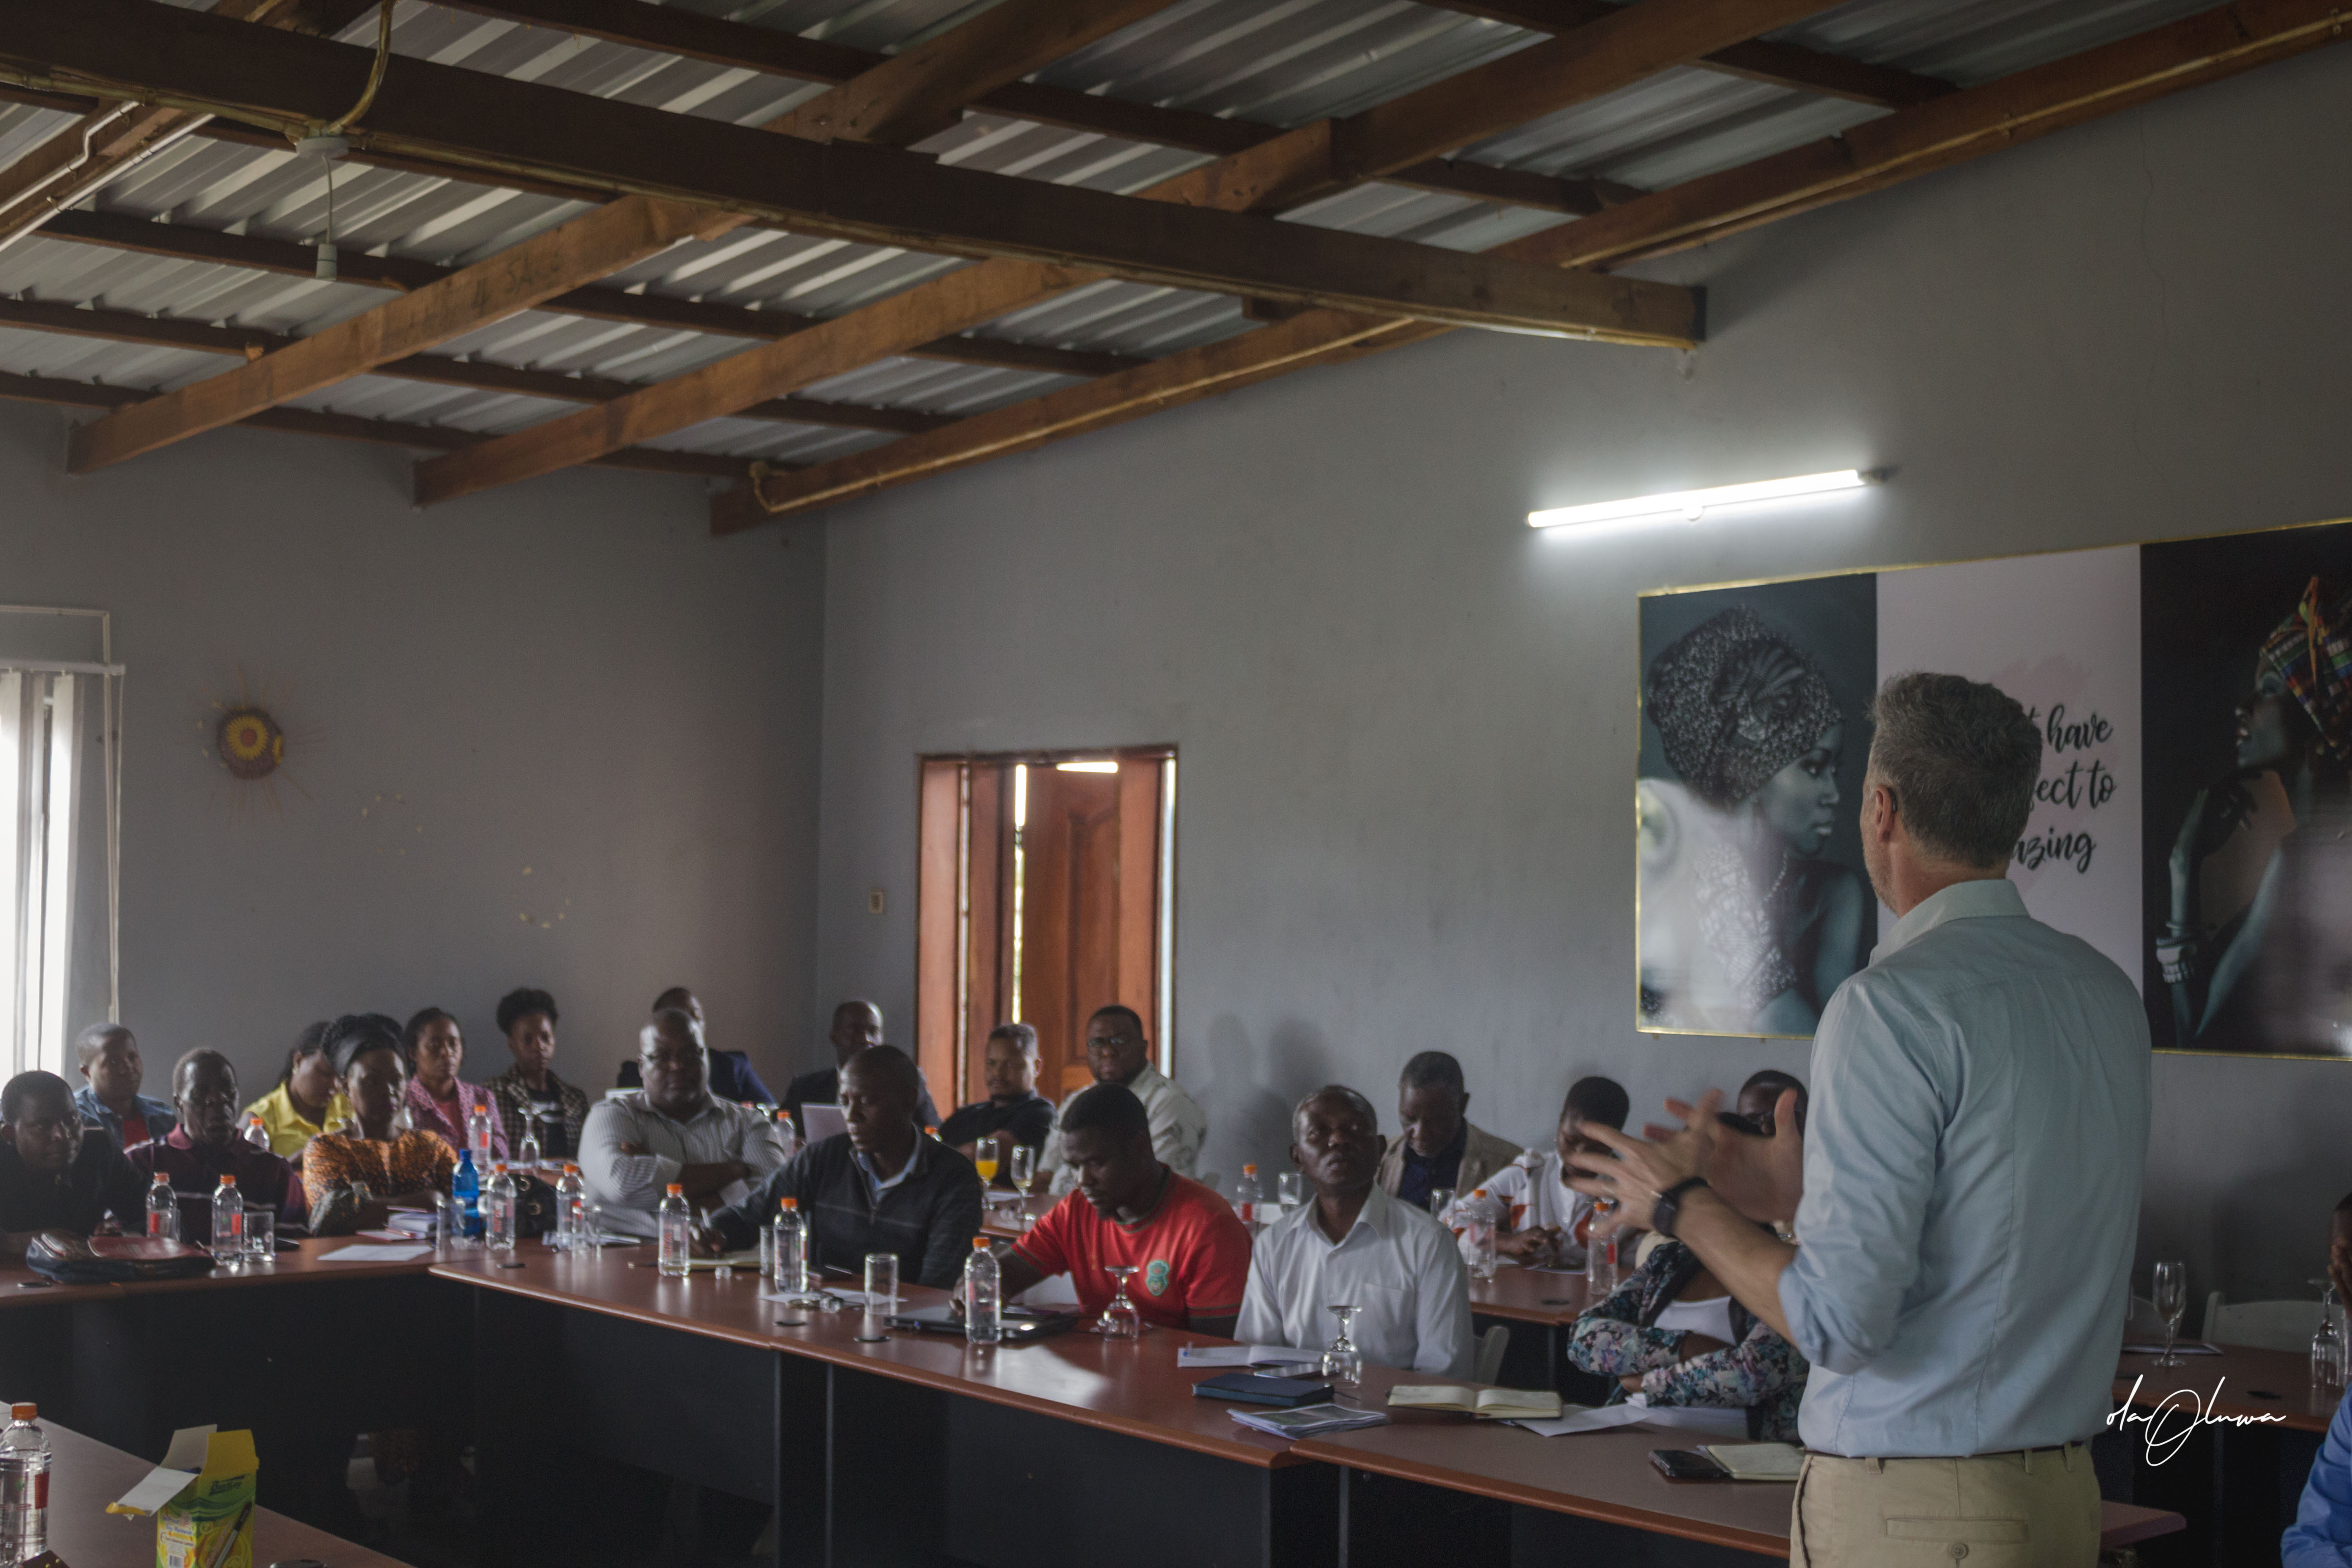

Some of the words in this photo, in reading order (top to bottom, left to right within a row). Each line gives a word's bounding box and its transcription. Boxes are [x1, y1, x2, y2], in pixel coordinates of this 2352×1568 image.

[2047, 704, 2114, 753] have
[2030, 761, 2083, 811] ect
[2087, 760, 2116, 809] to
